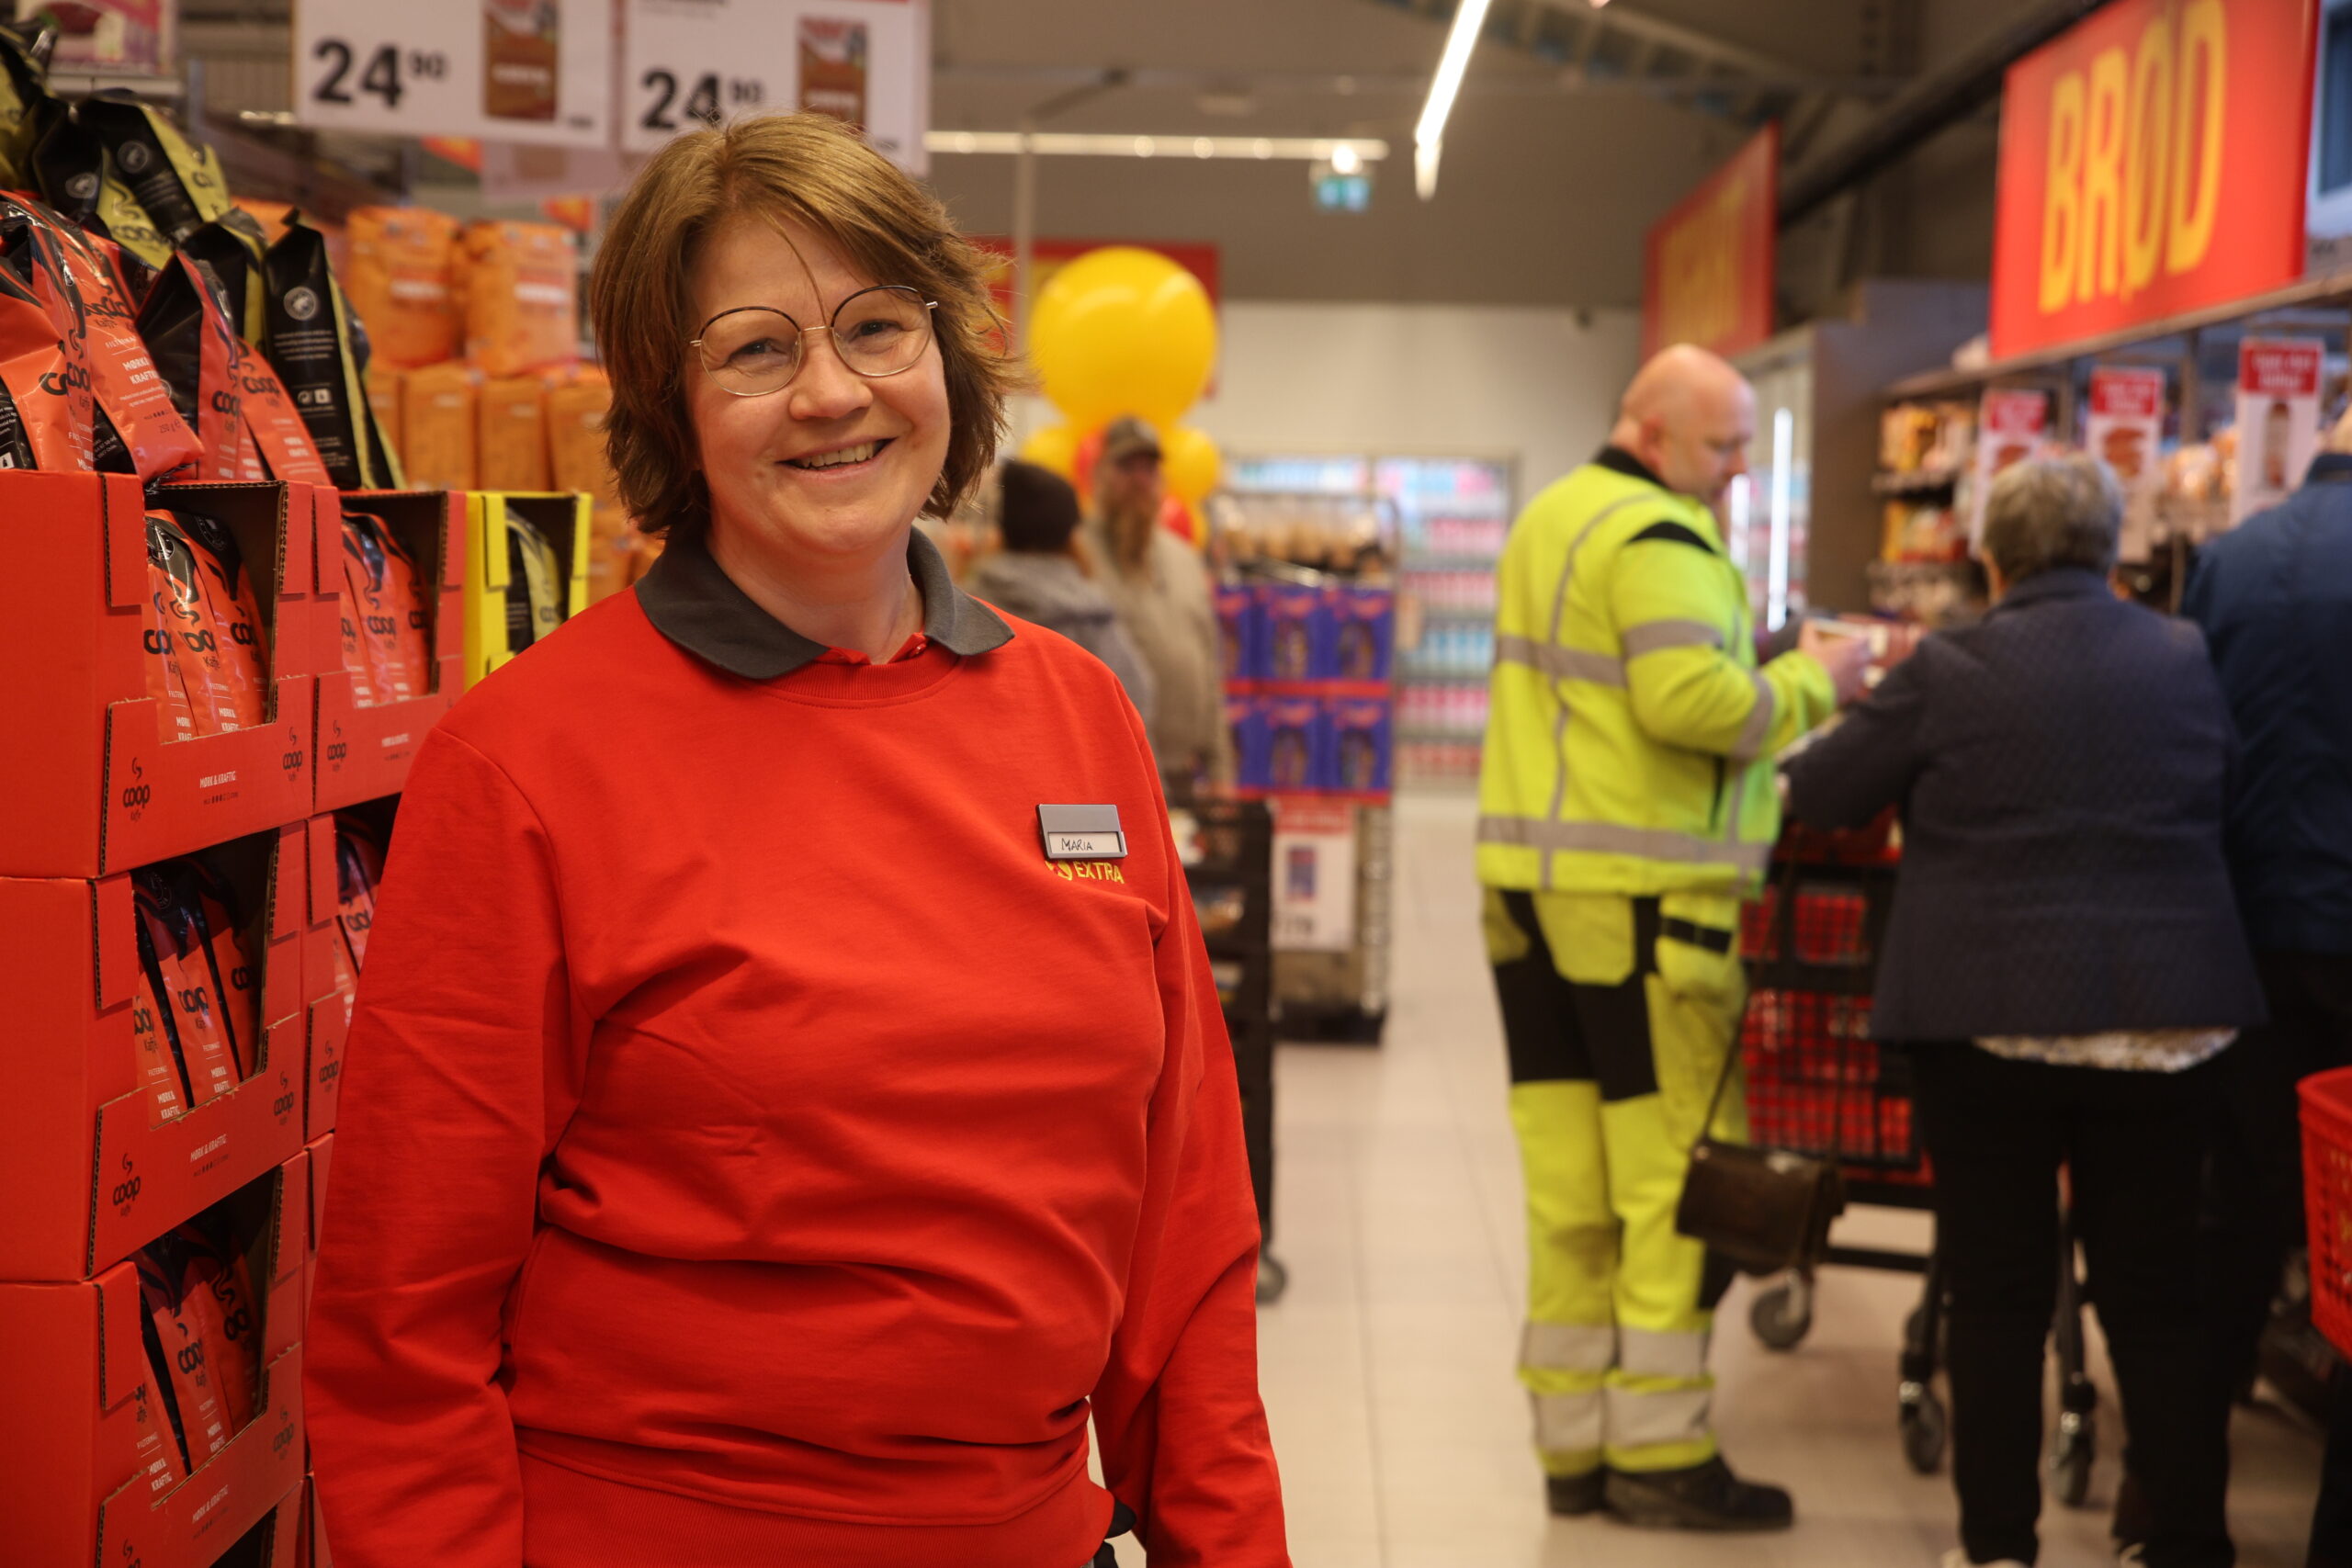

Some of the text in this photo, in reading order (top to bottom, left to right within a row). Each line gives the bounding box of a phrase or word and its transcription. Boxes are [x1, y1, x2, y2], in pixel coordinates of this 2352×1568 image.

[313, 39, 402, 109] 24
[641, 69, 723, 129] 24
[2038, 0, 2226, 315] BRØD
[283, 750, 303, 772] coop
[199, 775, 214, 788] MØRK
[218, 771, 236, 784] KRAFTIG
[123, 784, 151, 809] coop
[1061, 837, 1093, 852] MARIA
[1072, 860, 1125, 885] EXTRA
[209, 1134, 227, 1152] KRAFTIG
[113, 1176, 141, 1205] coop
[151, 1472, 173, 1492] KRAFTIG
